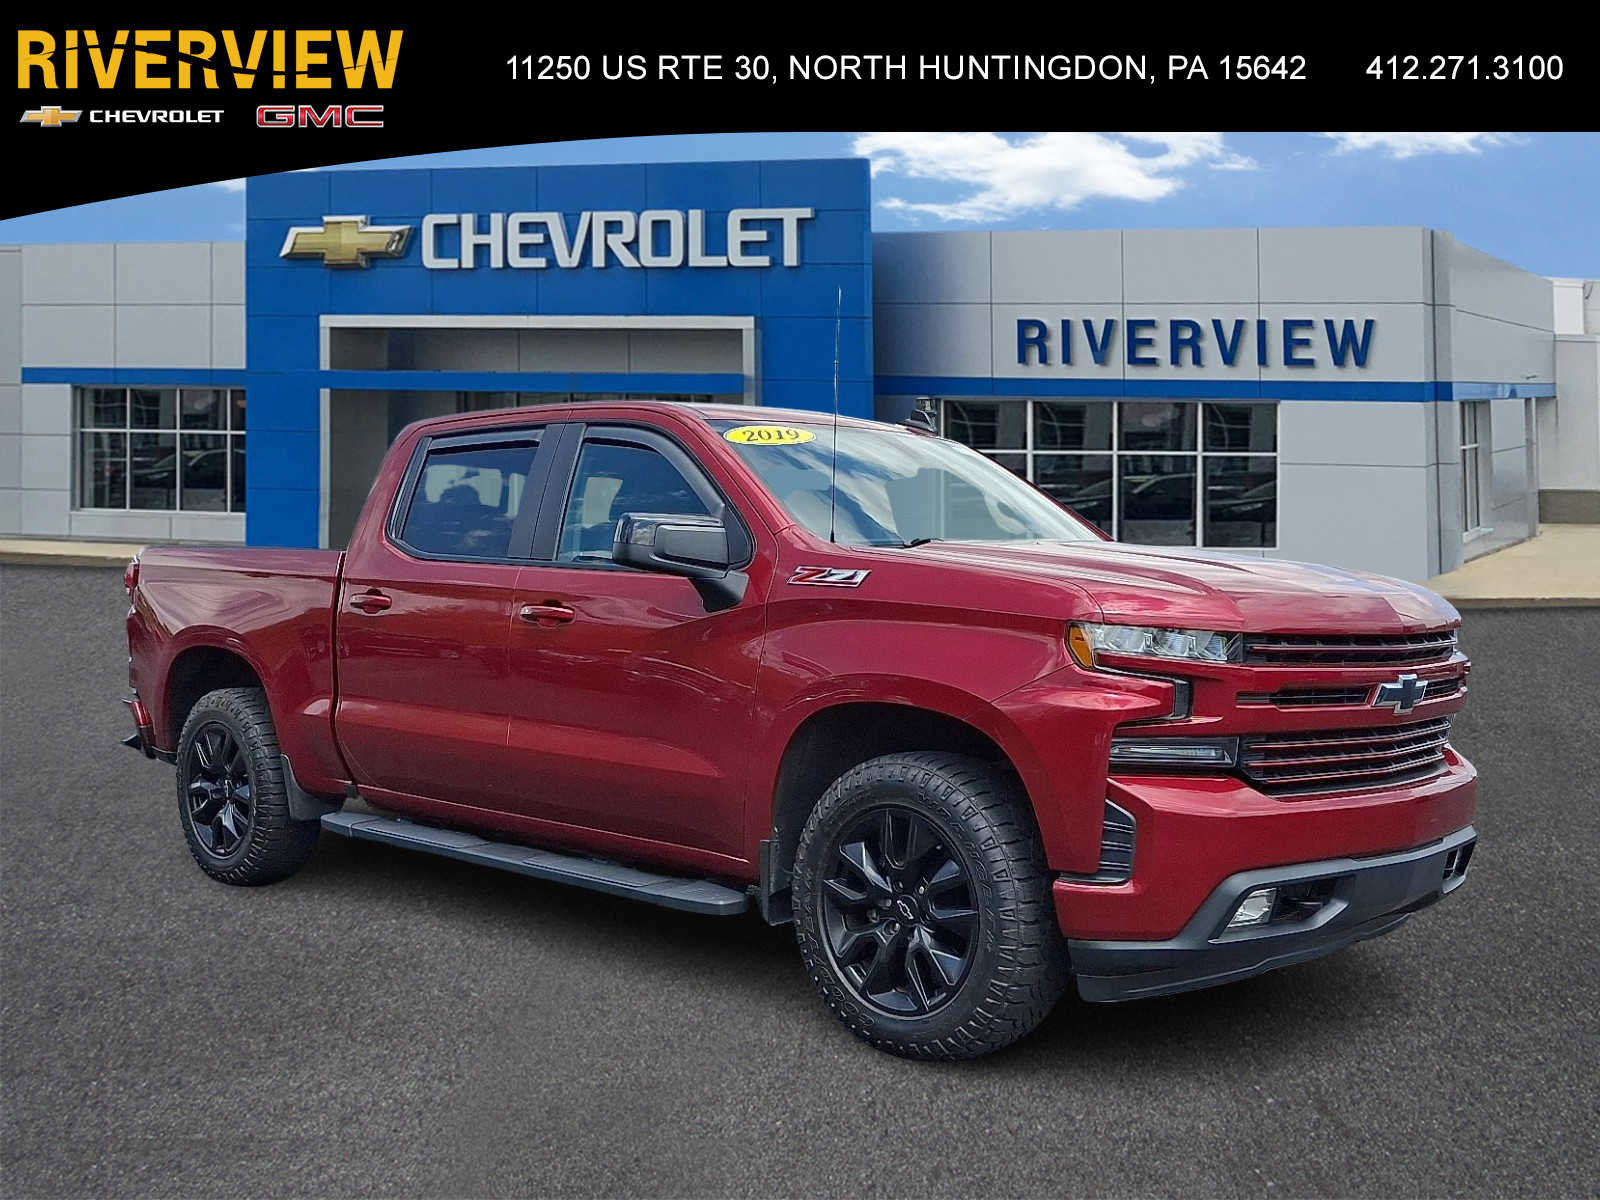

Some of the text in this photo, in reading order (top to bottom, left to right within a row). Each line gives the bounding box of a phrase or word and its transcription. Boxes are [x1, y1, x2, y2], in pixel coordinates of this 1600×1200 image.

[421, 206, 813, 270] CHEVROLET
[1016, 318, 1376, 369] RIVERVIEW
[742, 428, 801, 443] 2019
